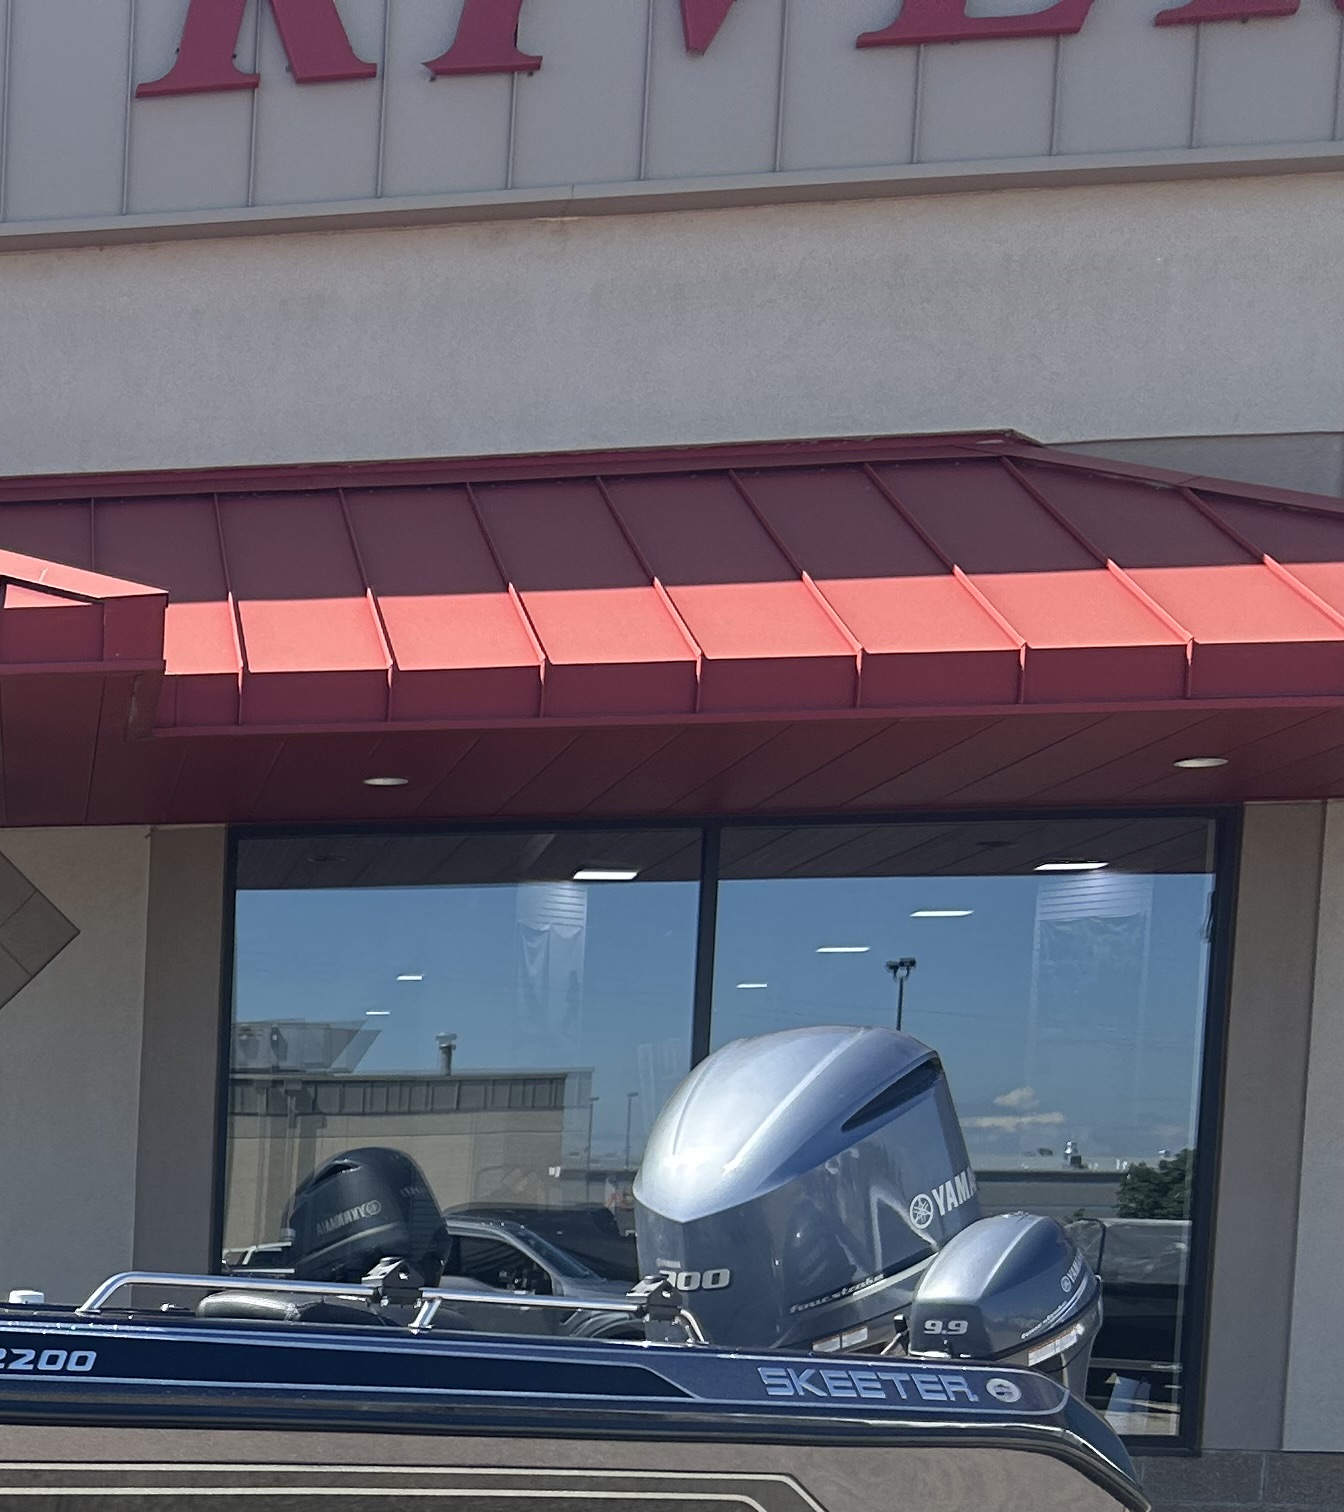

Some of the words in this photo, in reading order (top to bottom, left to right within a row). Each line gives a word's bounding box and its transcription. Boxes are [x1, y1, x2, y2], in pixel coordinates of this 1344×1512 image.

[931, 1166, 977, 1216] YAMA
[923, 1319, 969, 1335] 9.9
[757, 1366, 972, 1402] SKEETER
